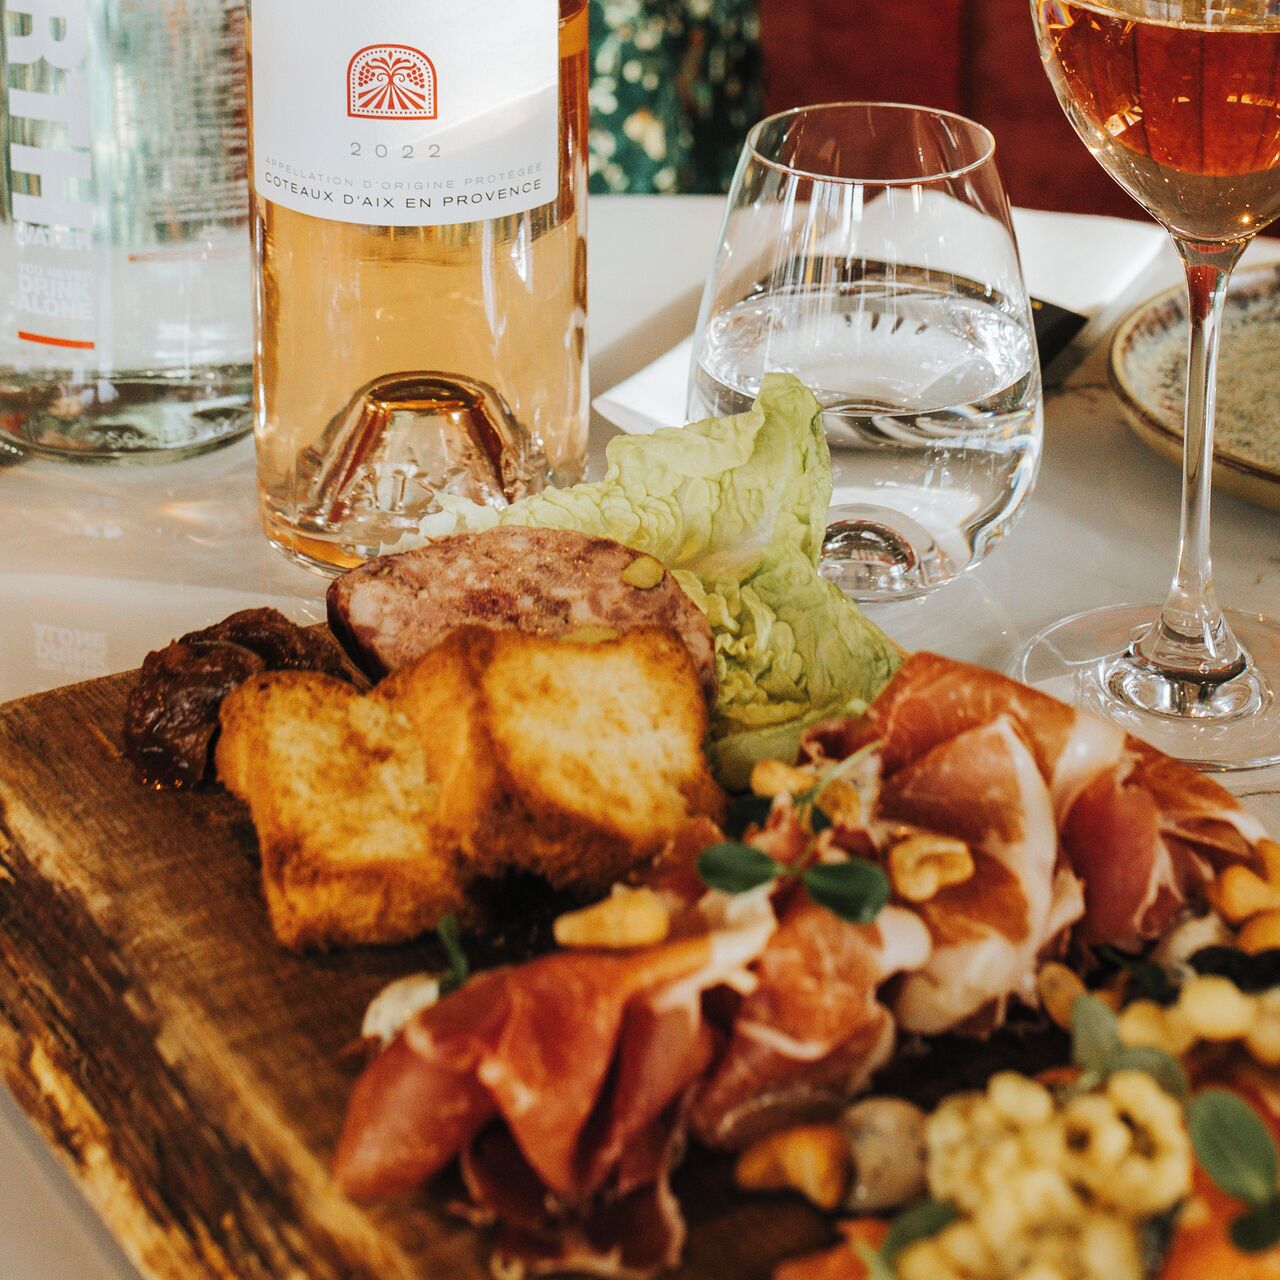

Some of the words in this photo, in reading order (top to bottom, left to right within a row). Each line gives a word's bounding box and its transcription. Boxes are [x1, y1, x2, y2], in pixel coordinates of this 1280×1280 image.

[349, 142, 442, 160] 2022
[265, 156, 354, 187] APPELLATION
[363, 178, 456, 191] D'ORIGINE
[264, 171, 334, 203] COTEAUX
[343, 194, 395, 209] D'AIX
[405, 197, 432, 209] EN
[442, 178, 543, 207] PROVENCE
[18, 272, 93, 302] DRINK
[17, 290, 95, 321] ALONE
